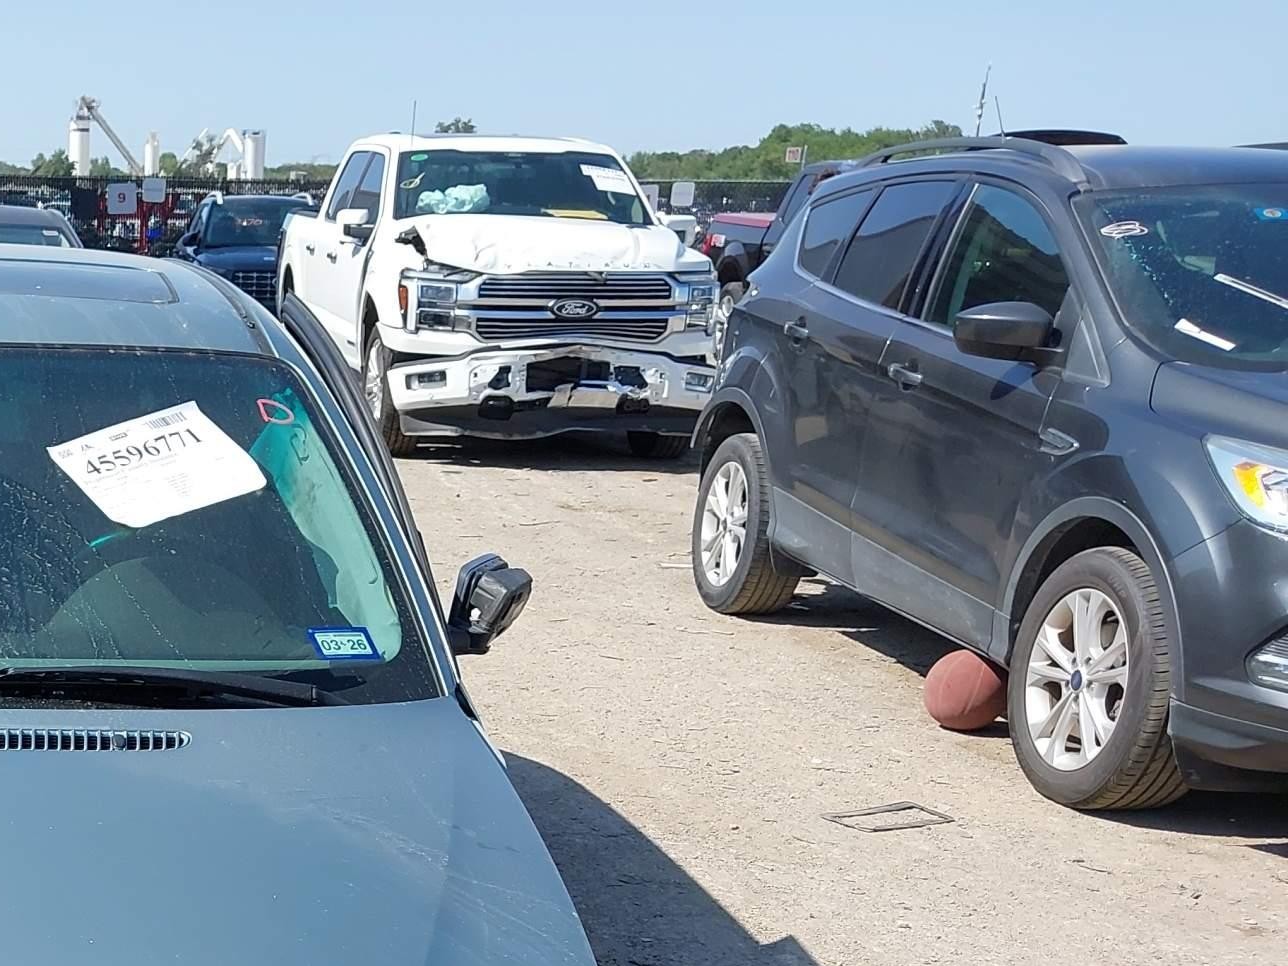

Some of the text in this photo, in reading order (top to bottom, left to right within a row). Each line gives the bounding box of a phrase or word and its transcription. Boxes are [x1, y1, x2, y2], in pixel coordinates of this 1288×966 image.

[117, 192, 127, 203] 9
[561, 303, 589, 315] Ford
[85, 428, 203, 477] 45596771
